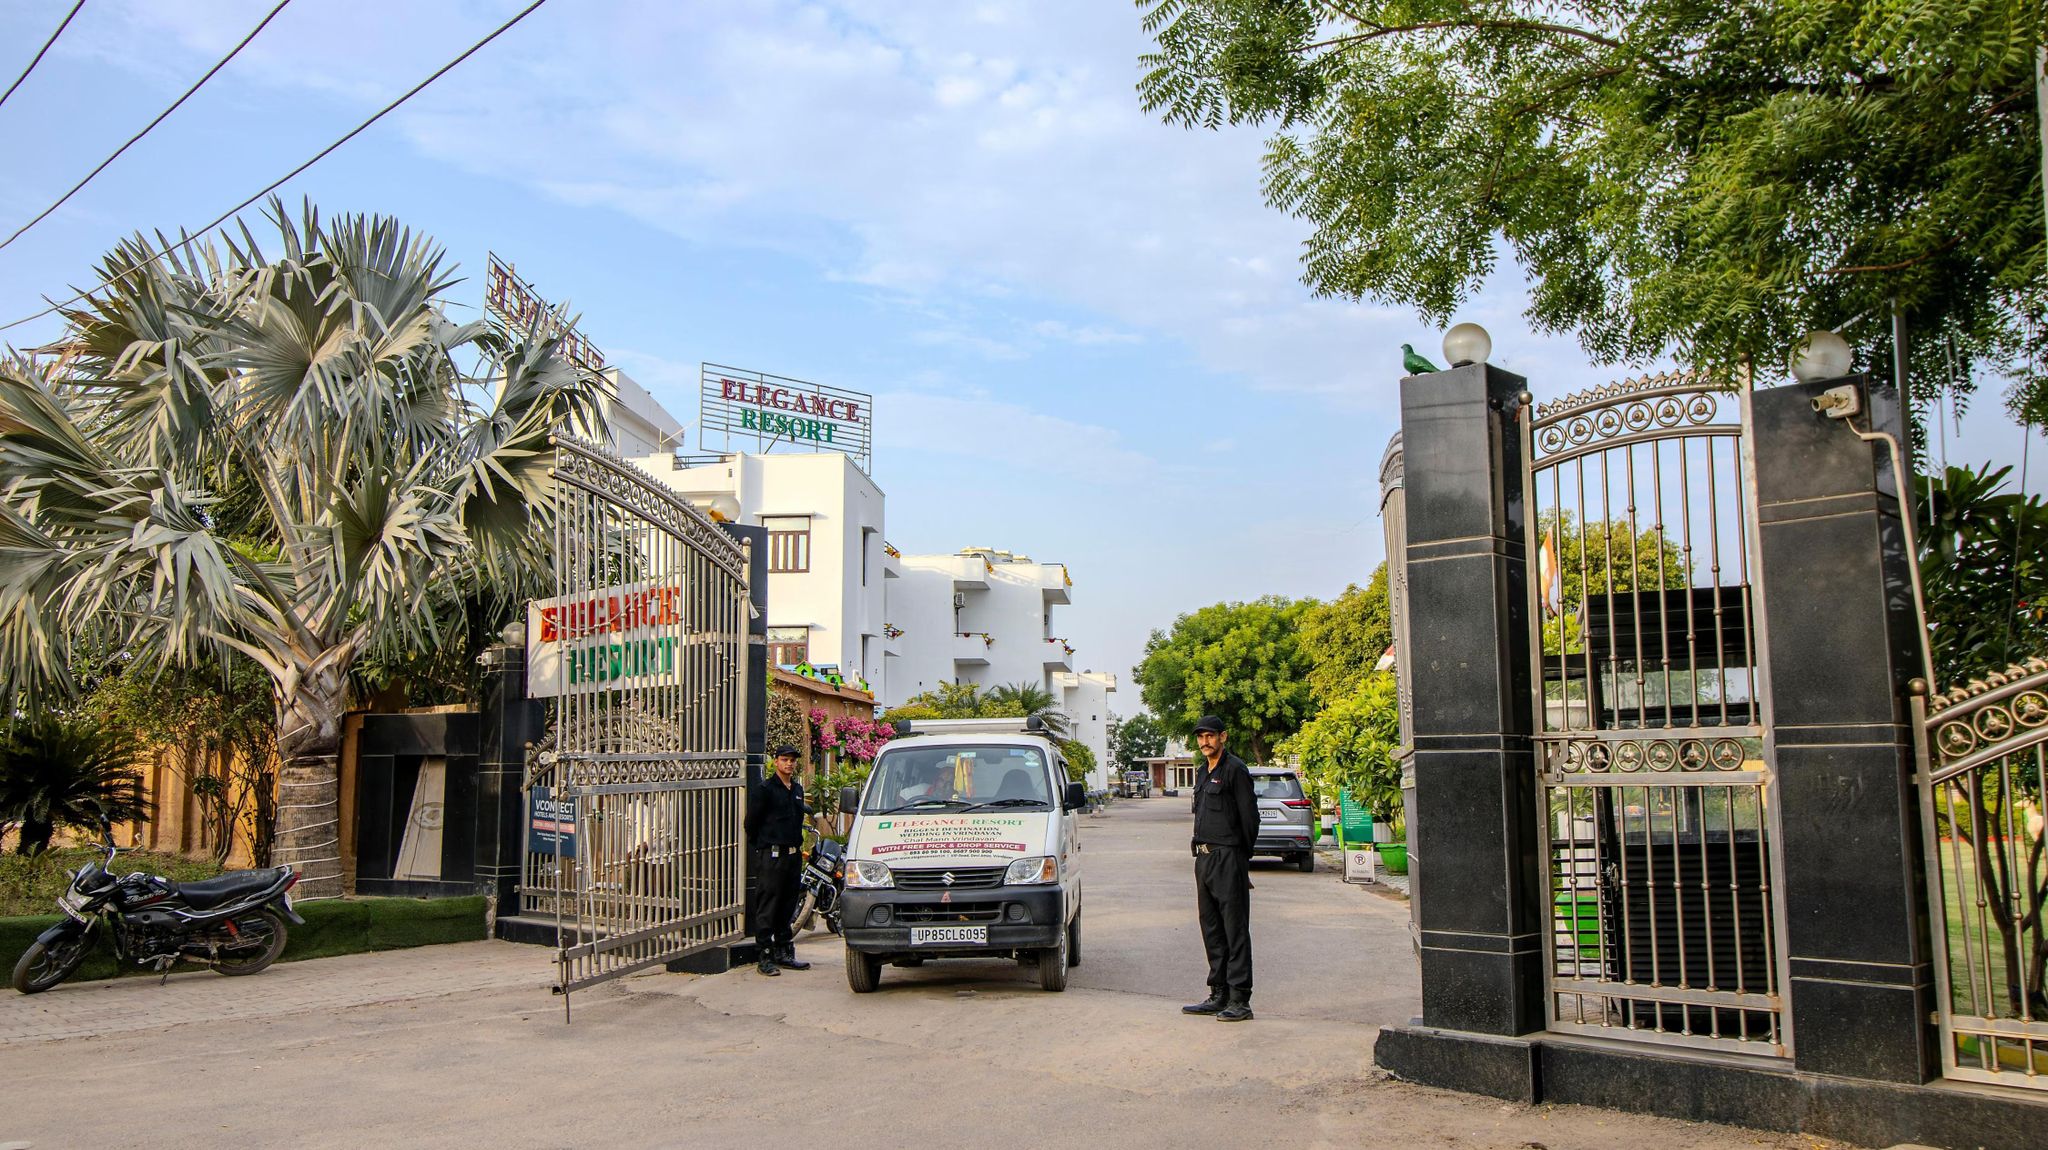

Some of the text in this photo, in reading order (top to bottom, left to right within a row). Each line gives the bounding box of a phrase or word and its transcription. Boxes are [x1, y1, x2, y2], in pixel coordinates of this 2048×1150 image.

[721, 378, 860, 422] ELEGANCE
[741, 407, 838, 442] RESORT
[535, 799, 574, 814] VCONECT
[893, 819, 968, 828] ELEGANCE
[878, 845, 900, 853] WITH
[917, 929, 986, 941] UP85CL6095
